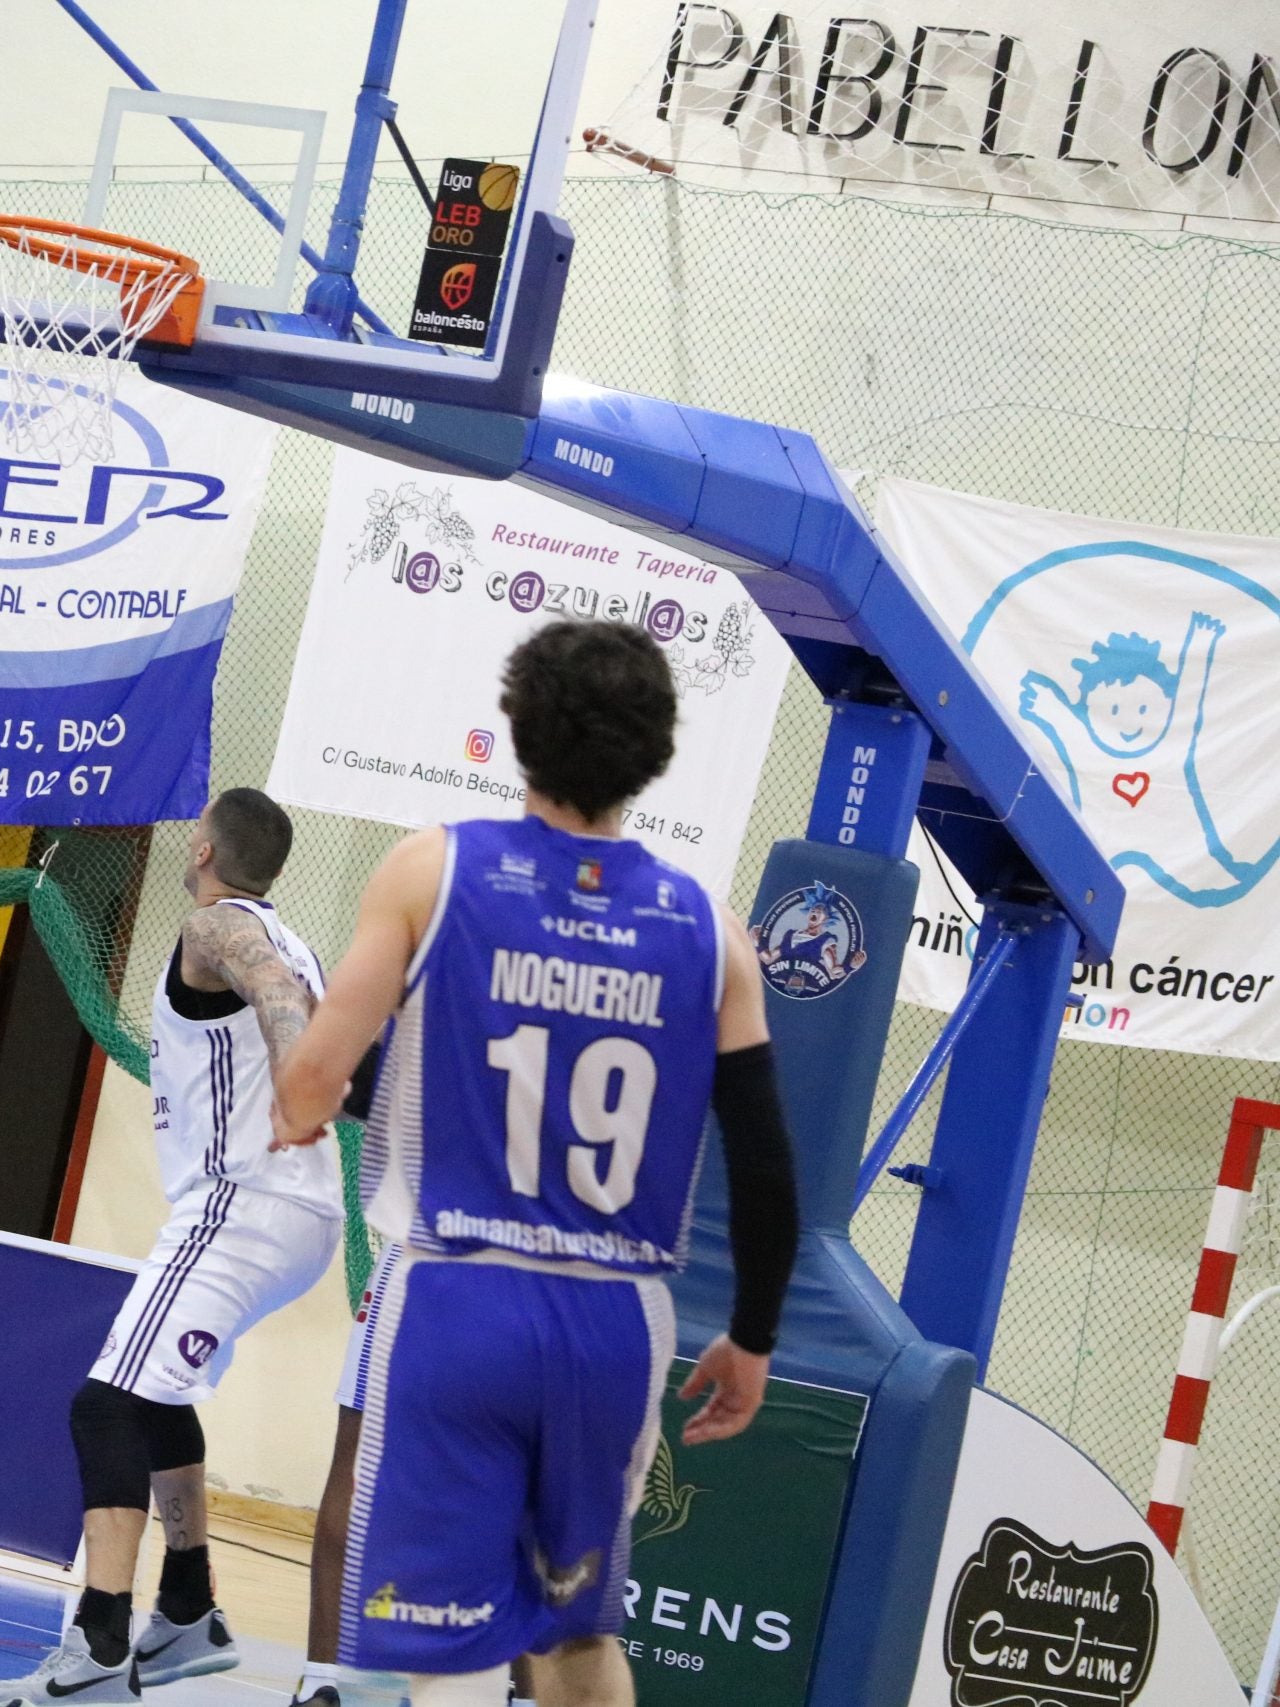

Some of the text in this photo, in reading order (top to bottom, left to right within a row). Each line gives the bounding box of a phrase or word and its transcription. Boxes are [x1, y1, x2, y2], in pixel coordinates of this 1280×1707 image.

[443, 170, 472, 192] Liga
[436, 201, 482, 227] LEB
[432, 225, 474, 246] ORO
[414, 309, 485, 332] baloncesto
[351, 392, 415, 424] MONDO
[555, 438, 614, 478] MONDO
[491, 523, 620, 566] Restaurante
[0, 718, 45, 755] 15,
[25, 770, 62, 799] 02
[68, 765, 114, 797] 67
[321, 745, 527, 802] C/ Gustavo Adolfo Bécque
[838, 746, 876, 845] MONDO
[634, 813, 666, 837] 341
[671, 820, 704, 846] 842
[557, 917, 637, 948] UCLM
[490, 948, 664, 1029] NOGUEROL
[769, 960, 830, 988] SIN LIMITE
[1130, 956, 1274, 1004] cáncer
[487, 1022, 658, 1217] 19
[1007, 1550, 1120, 1614] Restaurante
[653, 1646, 705, 1672] 1969
[969, 1610, 1133, 1685] Casa Jaime
